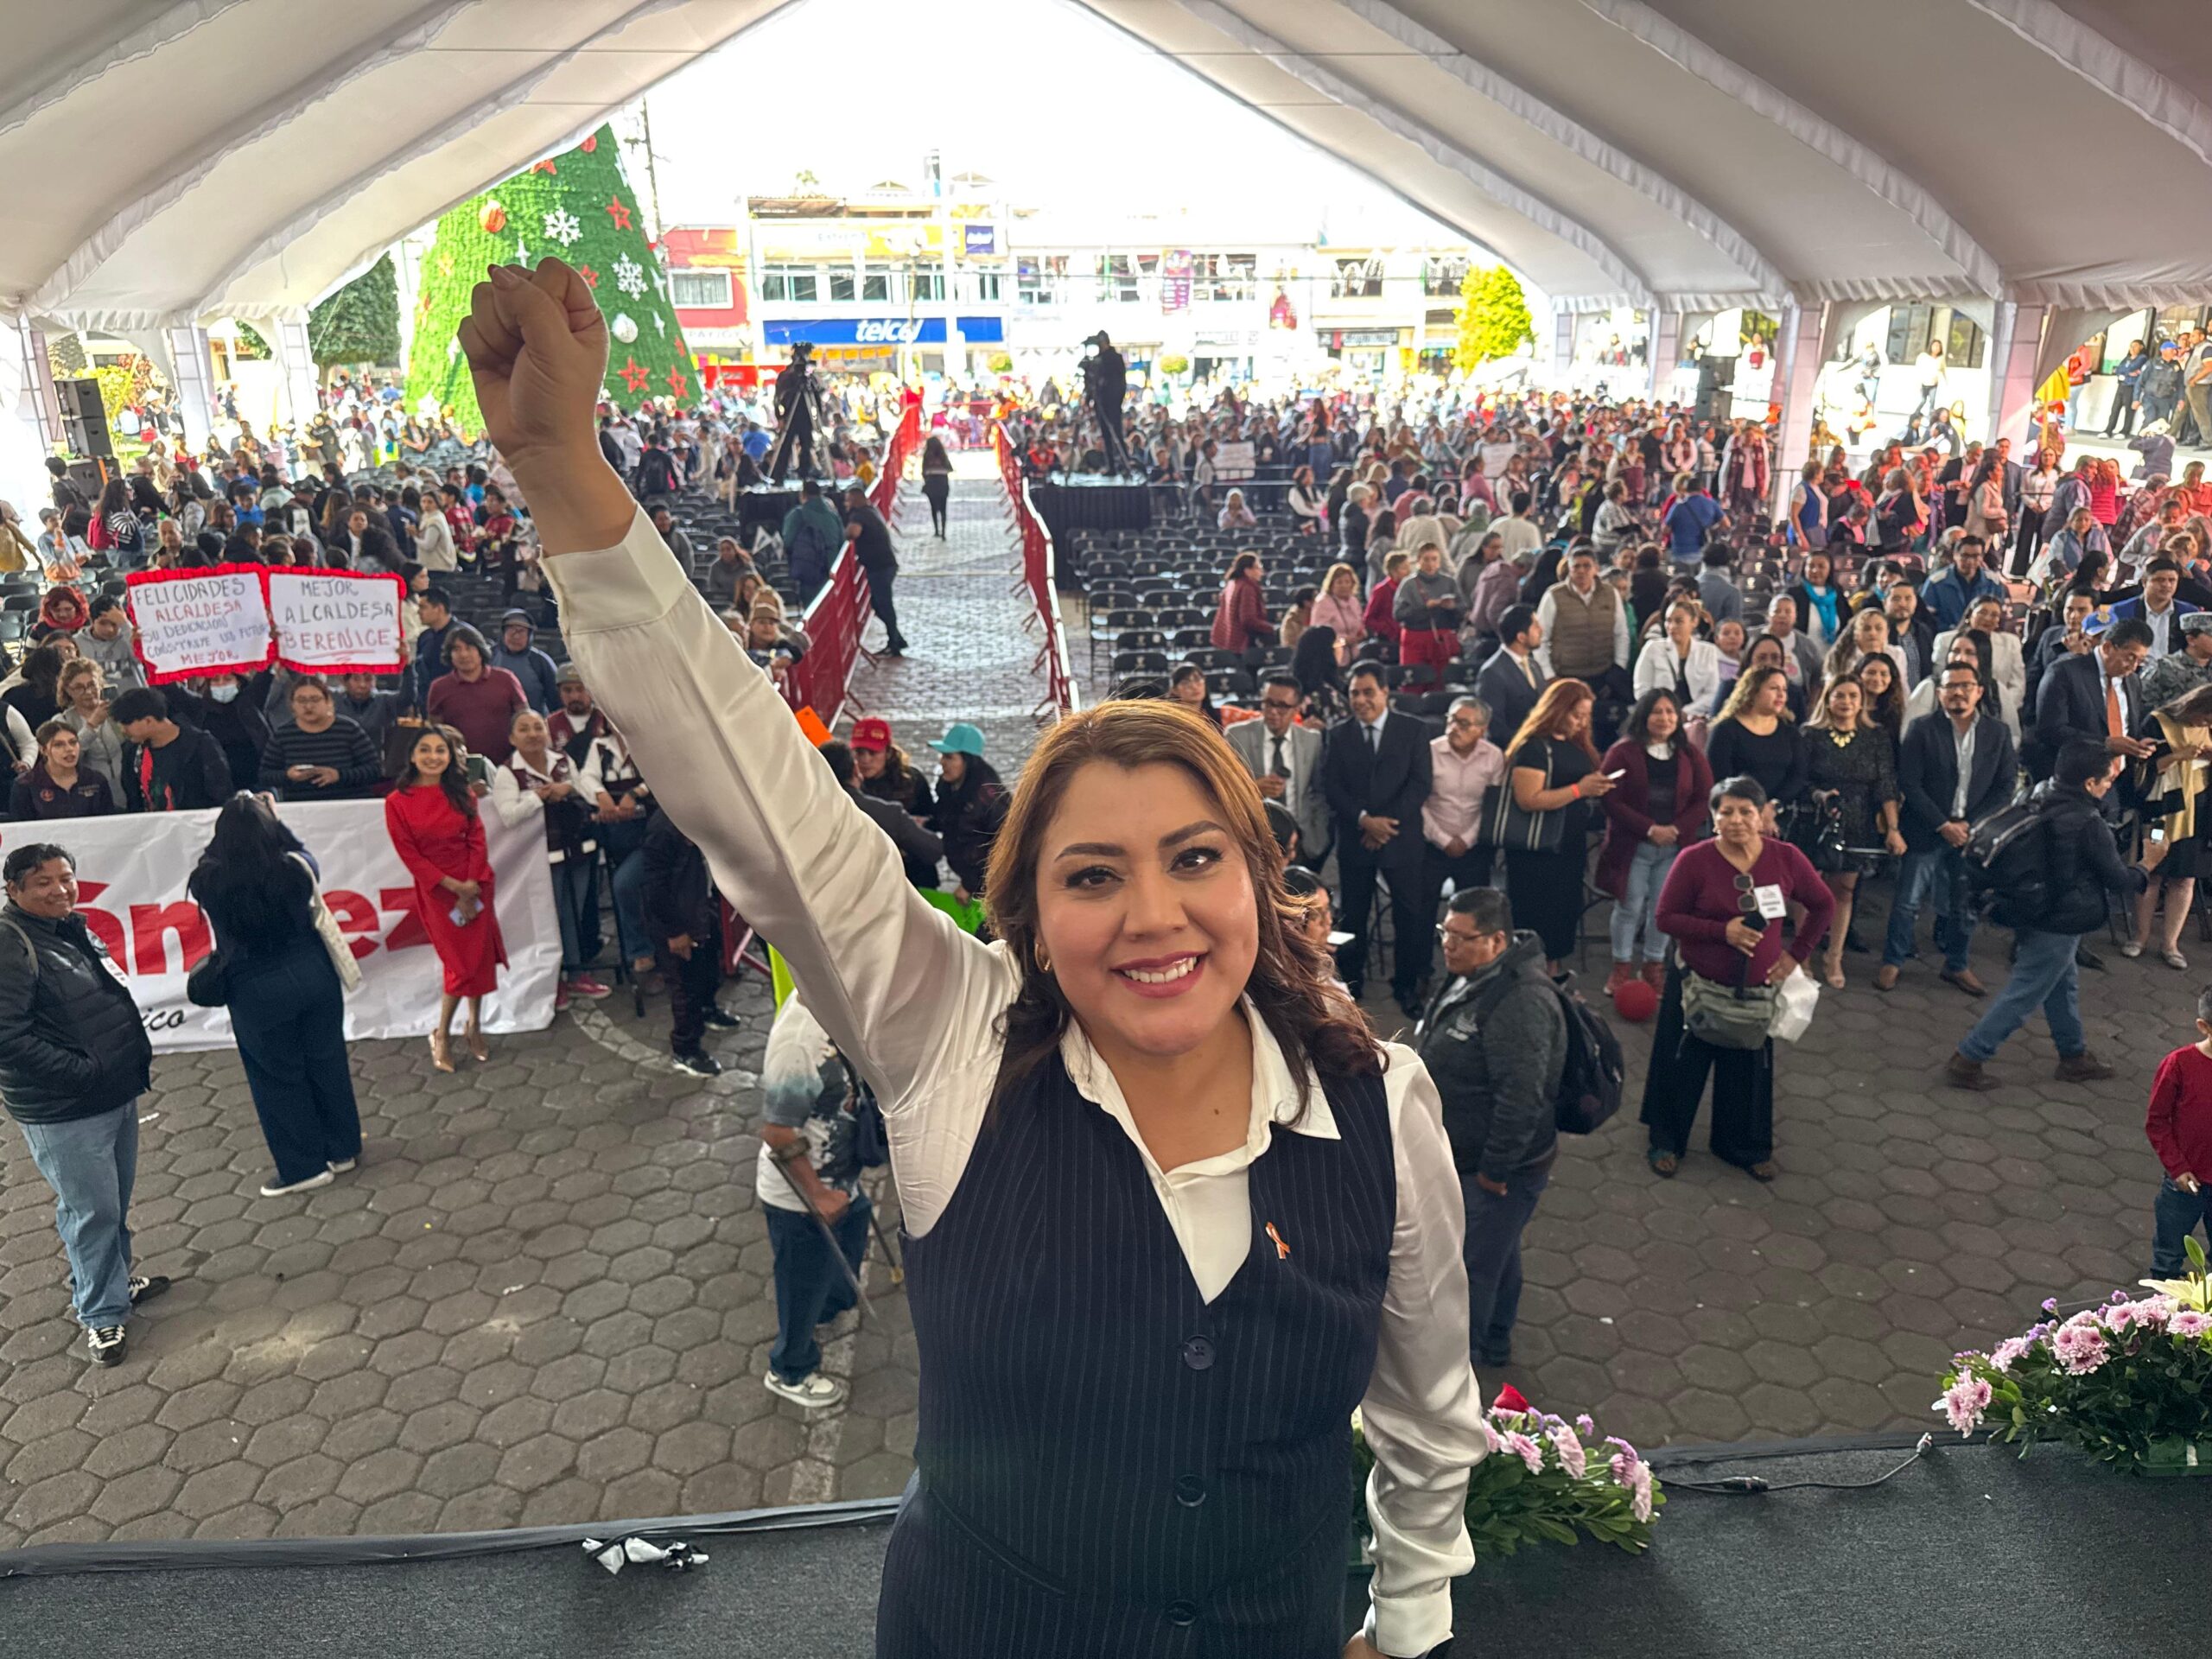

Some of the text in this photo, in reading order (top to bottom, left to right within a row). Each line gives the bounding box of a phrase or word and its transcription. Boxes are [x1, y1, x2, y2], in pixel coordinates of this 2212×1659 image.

[855, 318, 925, 342] telcel
[134, 577, 245, 606] FELICIDADES
[301, 579, 359, 597] MEJOR
[156, 600, 243, 622] ALCALDESA
[285, 601, 394, 624] ALCALDESA
[283, 626, 391, 652] BERENICE
[180, 650, 239, 664] MEJOR
